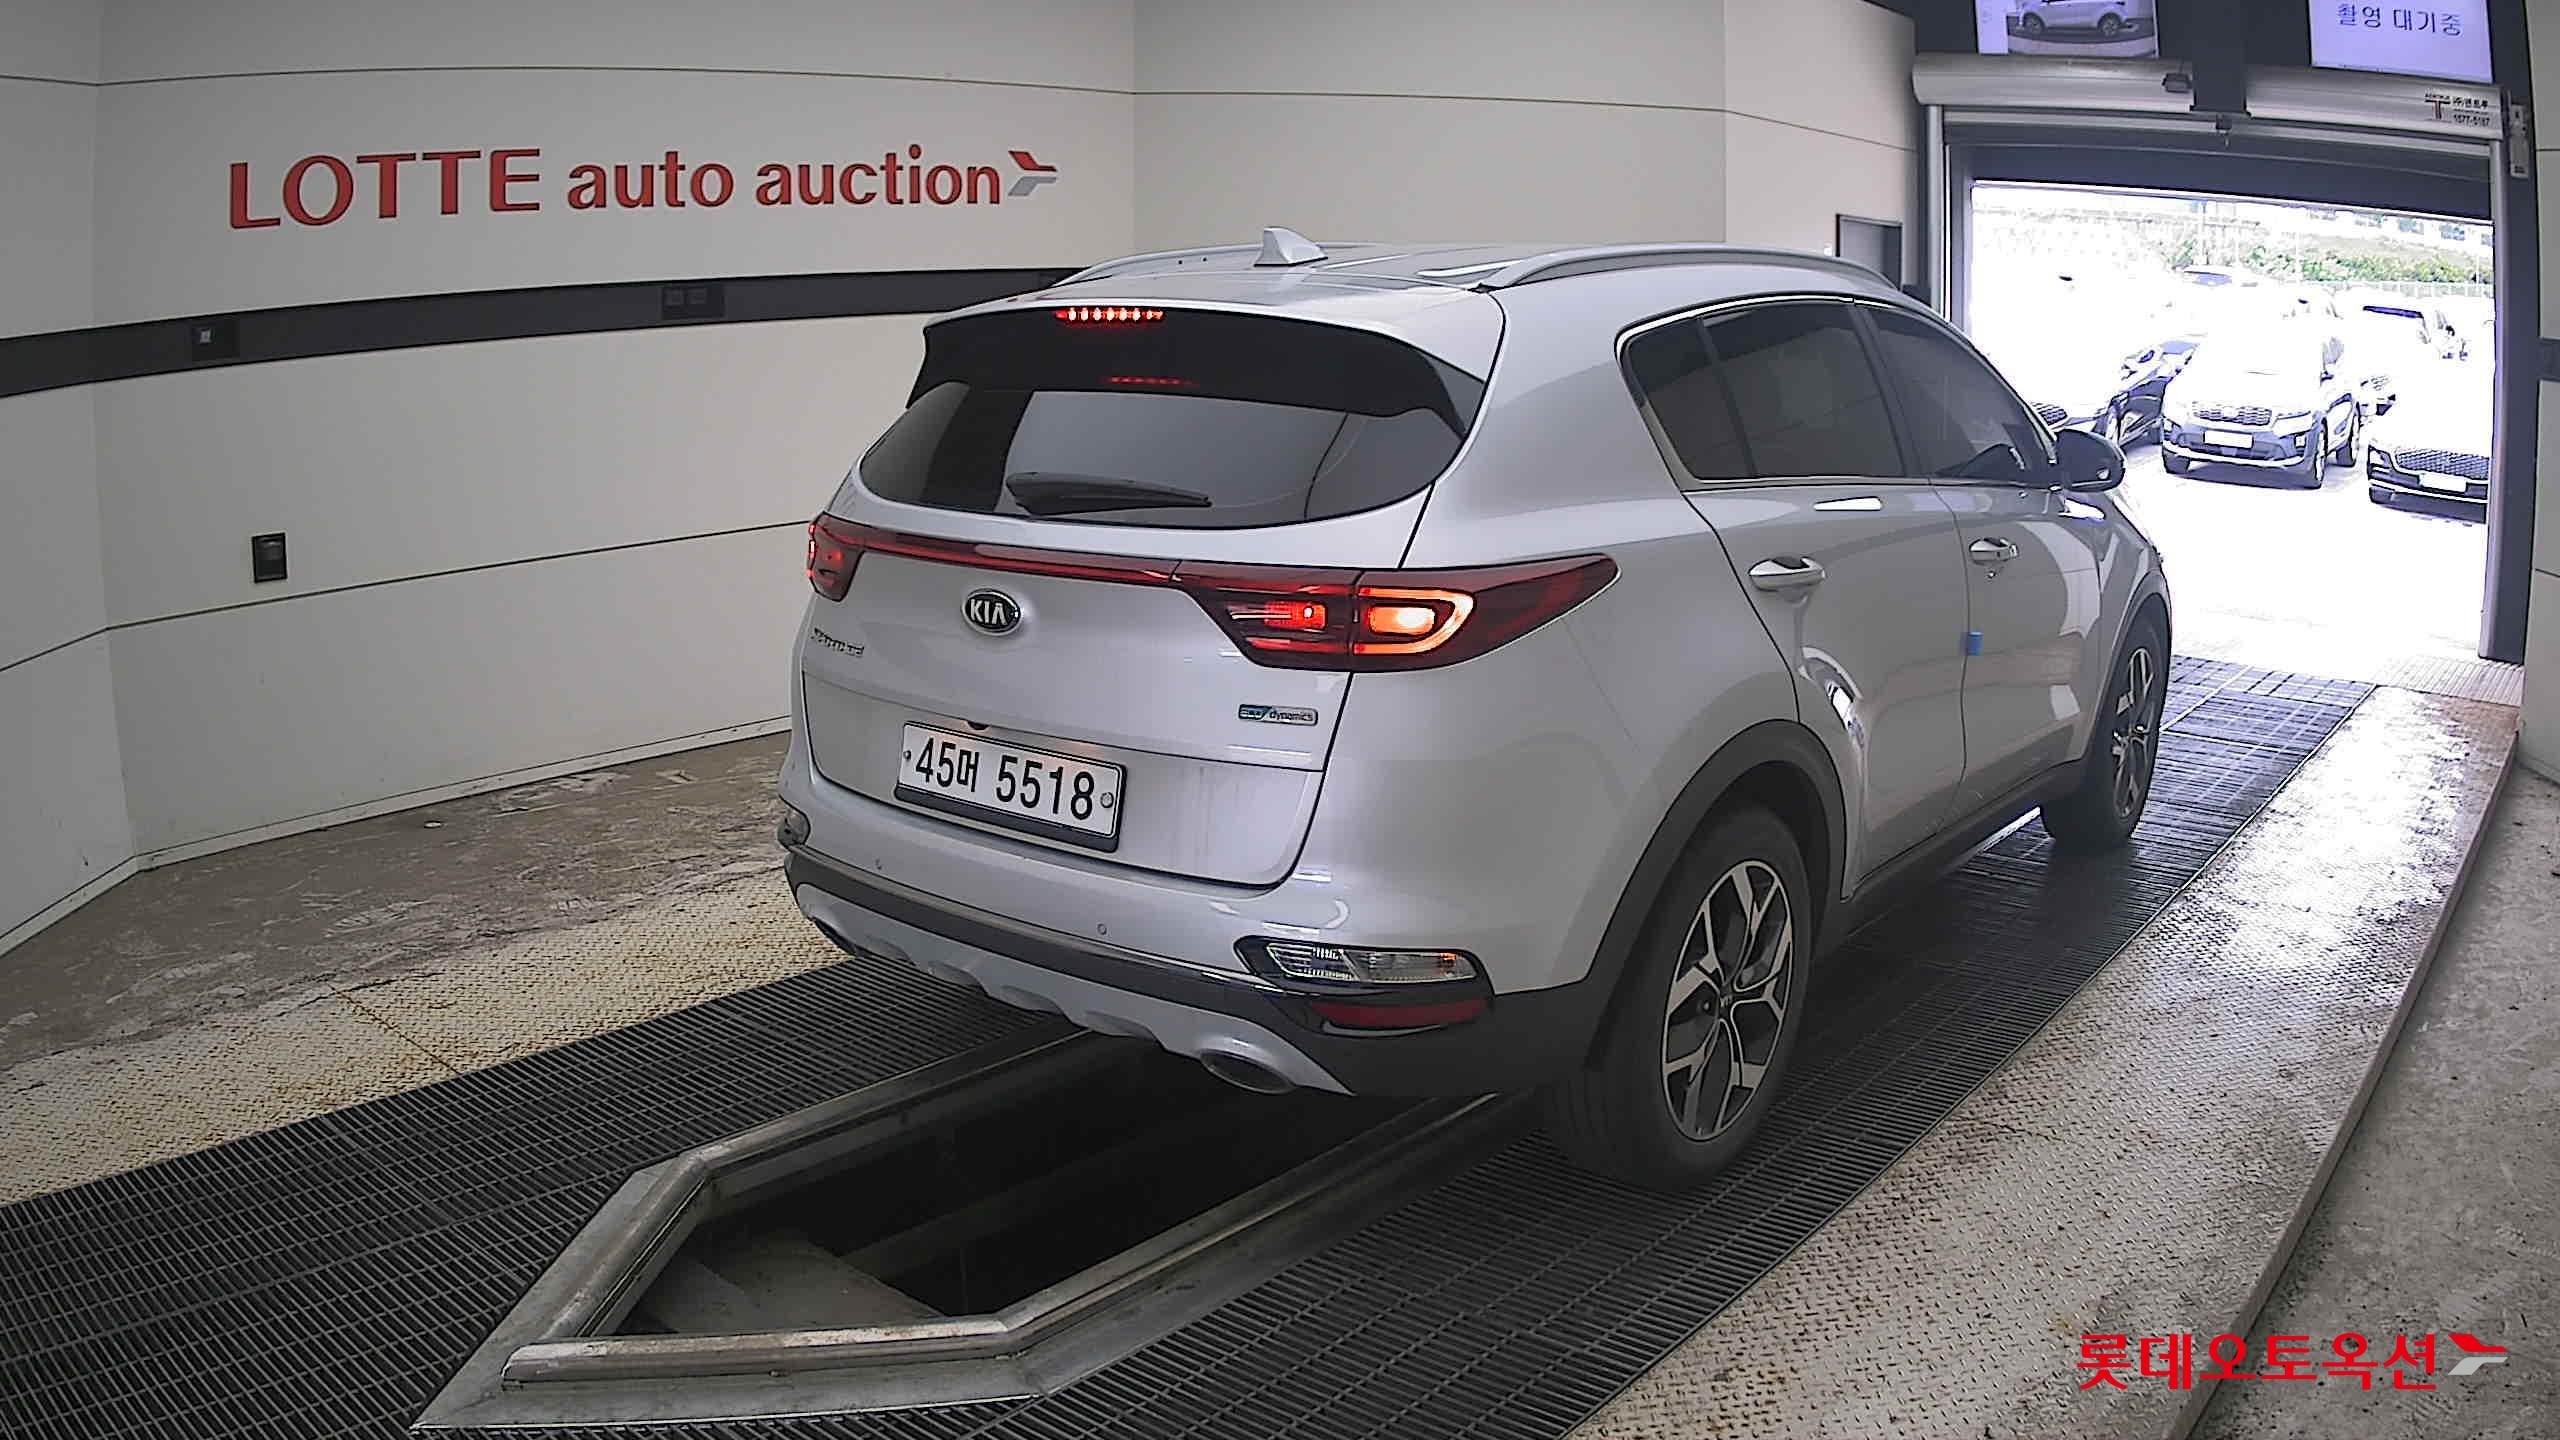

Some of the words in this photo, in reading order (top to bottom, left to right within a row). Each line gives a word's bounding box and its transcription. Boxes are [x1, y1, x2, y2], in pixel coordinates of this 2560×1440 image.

[2338, 4, 2381, 28] 촬영
[2393, 9, 2461, 36] 대기중
[230, 149, 540, 229] LOTTE
[567, 151, 734, 209] auto
[756, 144, 1000, 206] auction
[970, 598, 1008, 626] KIA
[916, 737, 980, 793] 45머
[996, 754, 1095, 820] 5518
